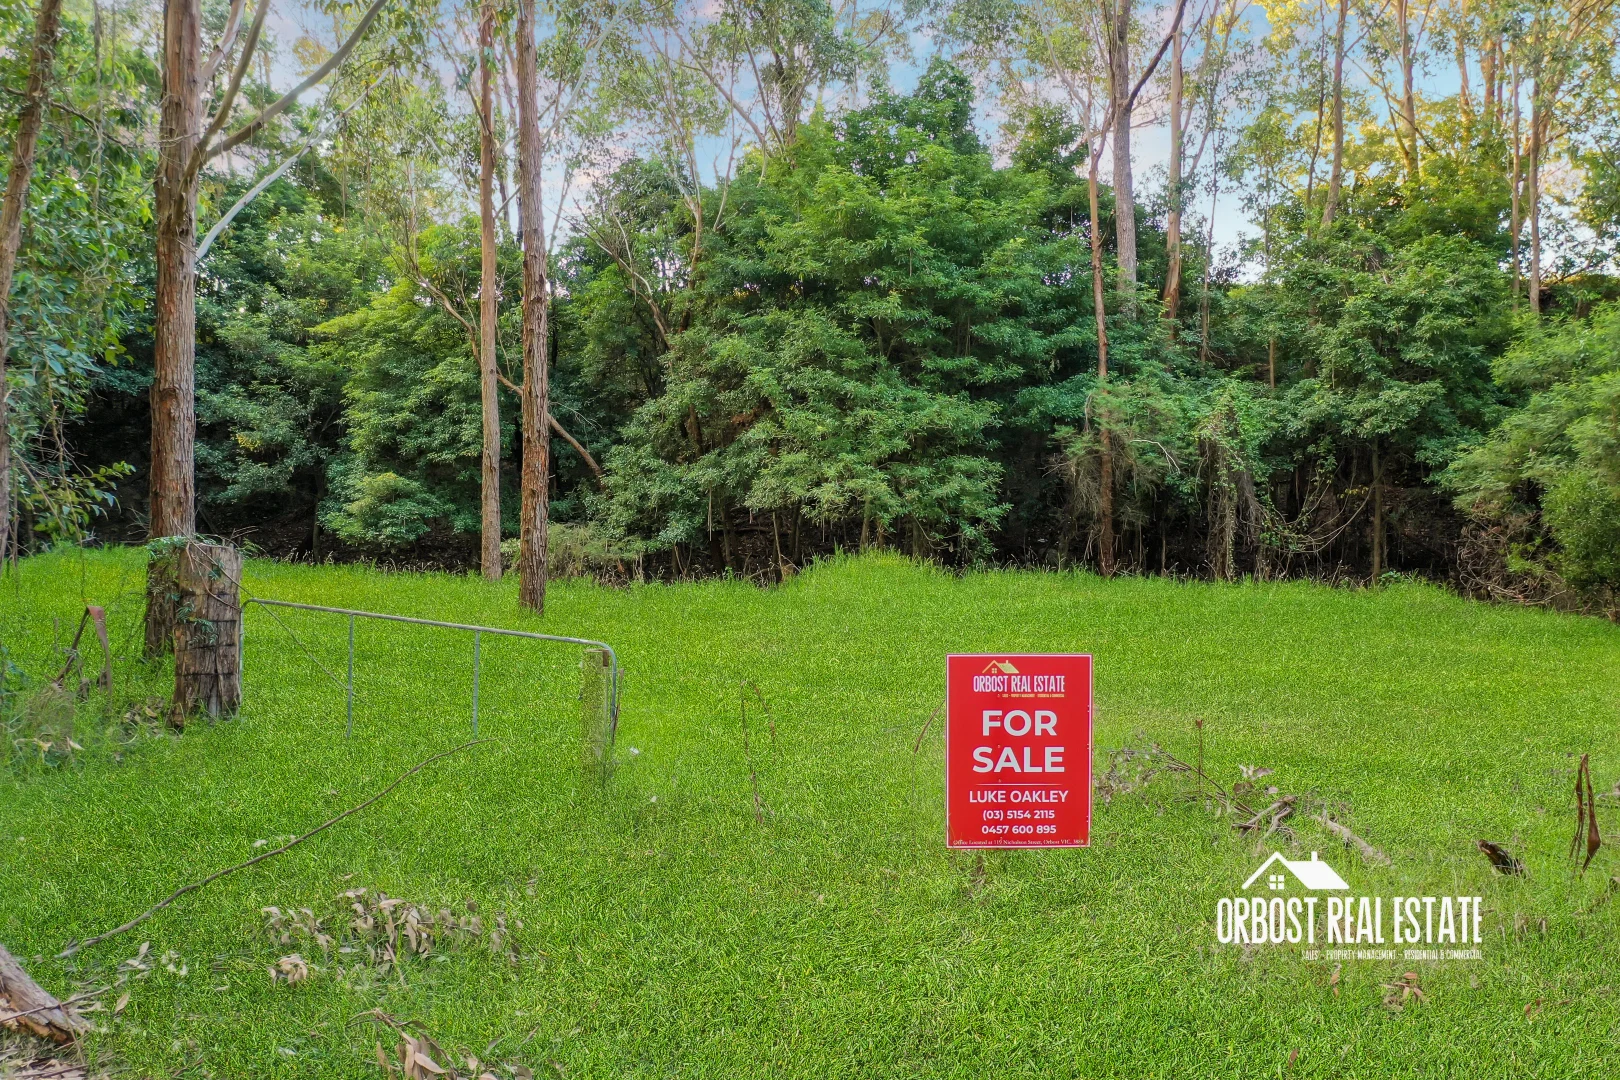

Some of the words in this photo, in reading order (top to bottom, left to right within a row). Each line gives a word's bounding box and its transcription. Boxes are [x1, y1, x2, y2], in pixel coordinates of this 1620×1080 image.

[973, 675, 1008, 692] ORBOST
[1011, 675, 1031, 692] REAL
[1033, 675, 1065, 692] ESTATE
[982, 709, 1058, 737] FOR
[972, 746, 1065, 773] SALE
[969, 790, 1006, 803] LUKE
[1010, 790, 1069, 803] OAKLEY
[982, 809, 1004, 821] (03)
[1006, 810, 1031, 819] 5154
[1034, 810, 1055, 819] 2115
[981, 825, 1009, 834] 0457
[1012, 825, 1033, 834] 600
[1036, 825, 1057, 834] 895
